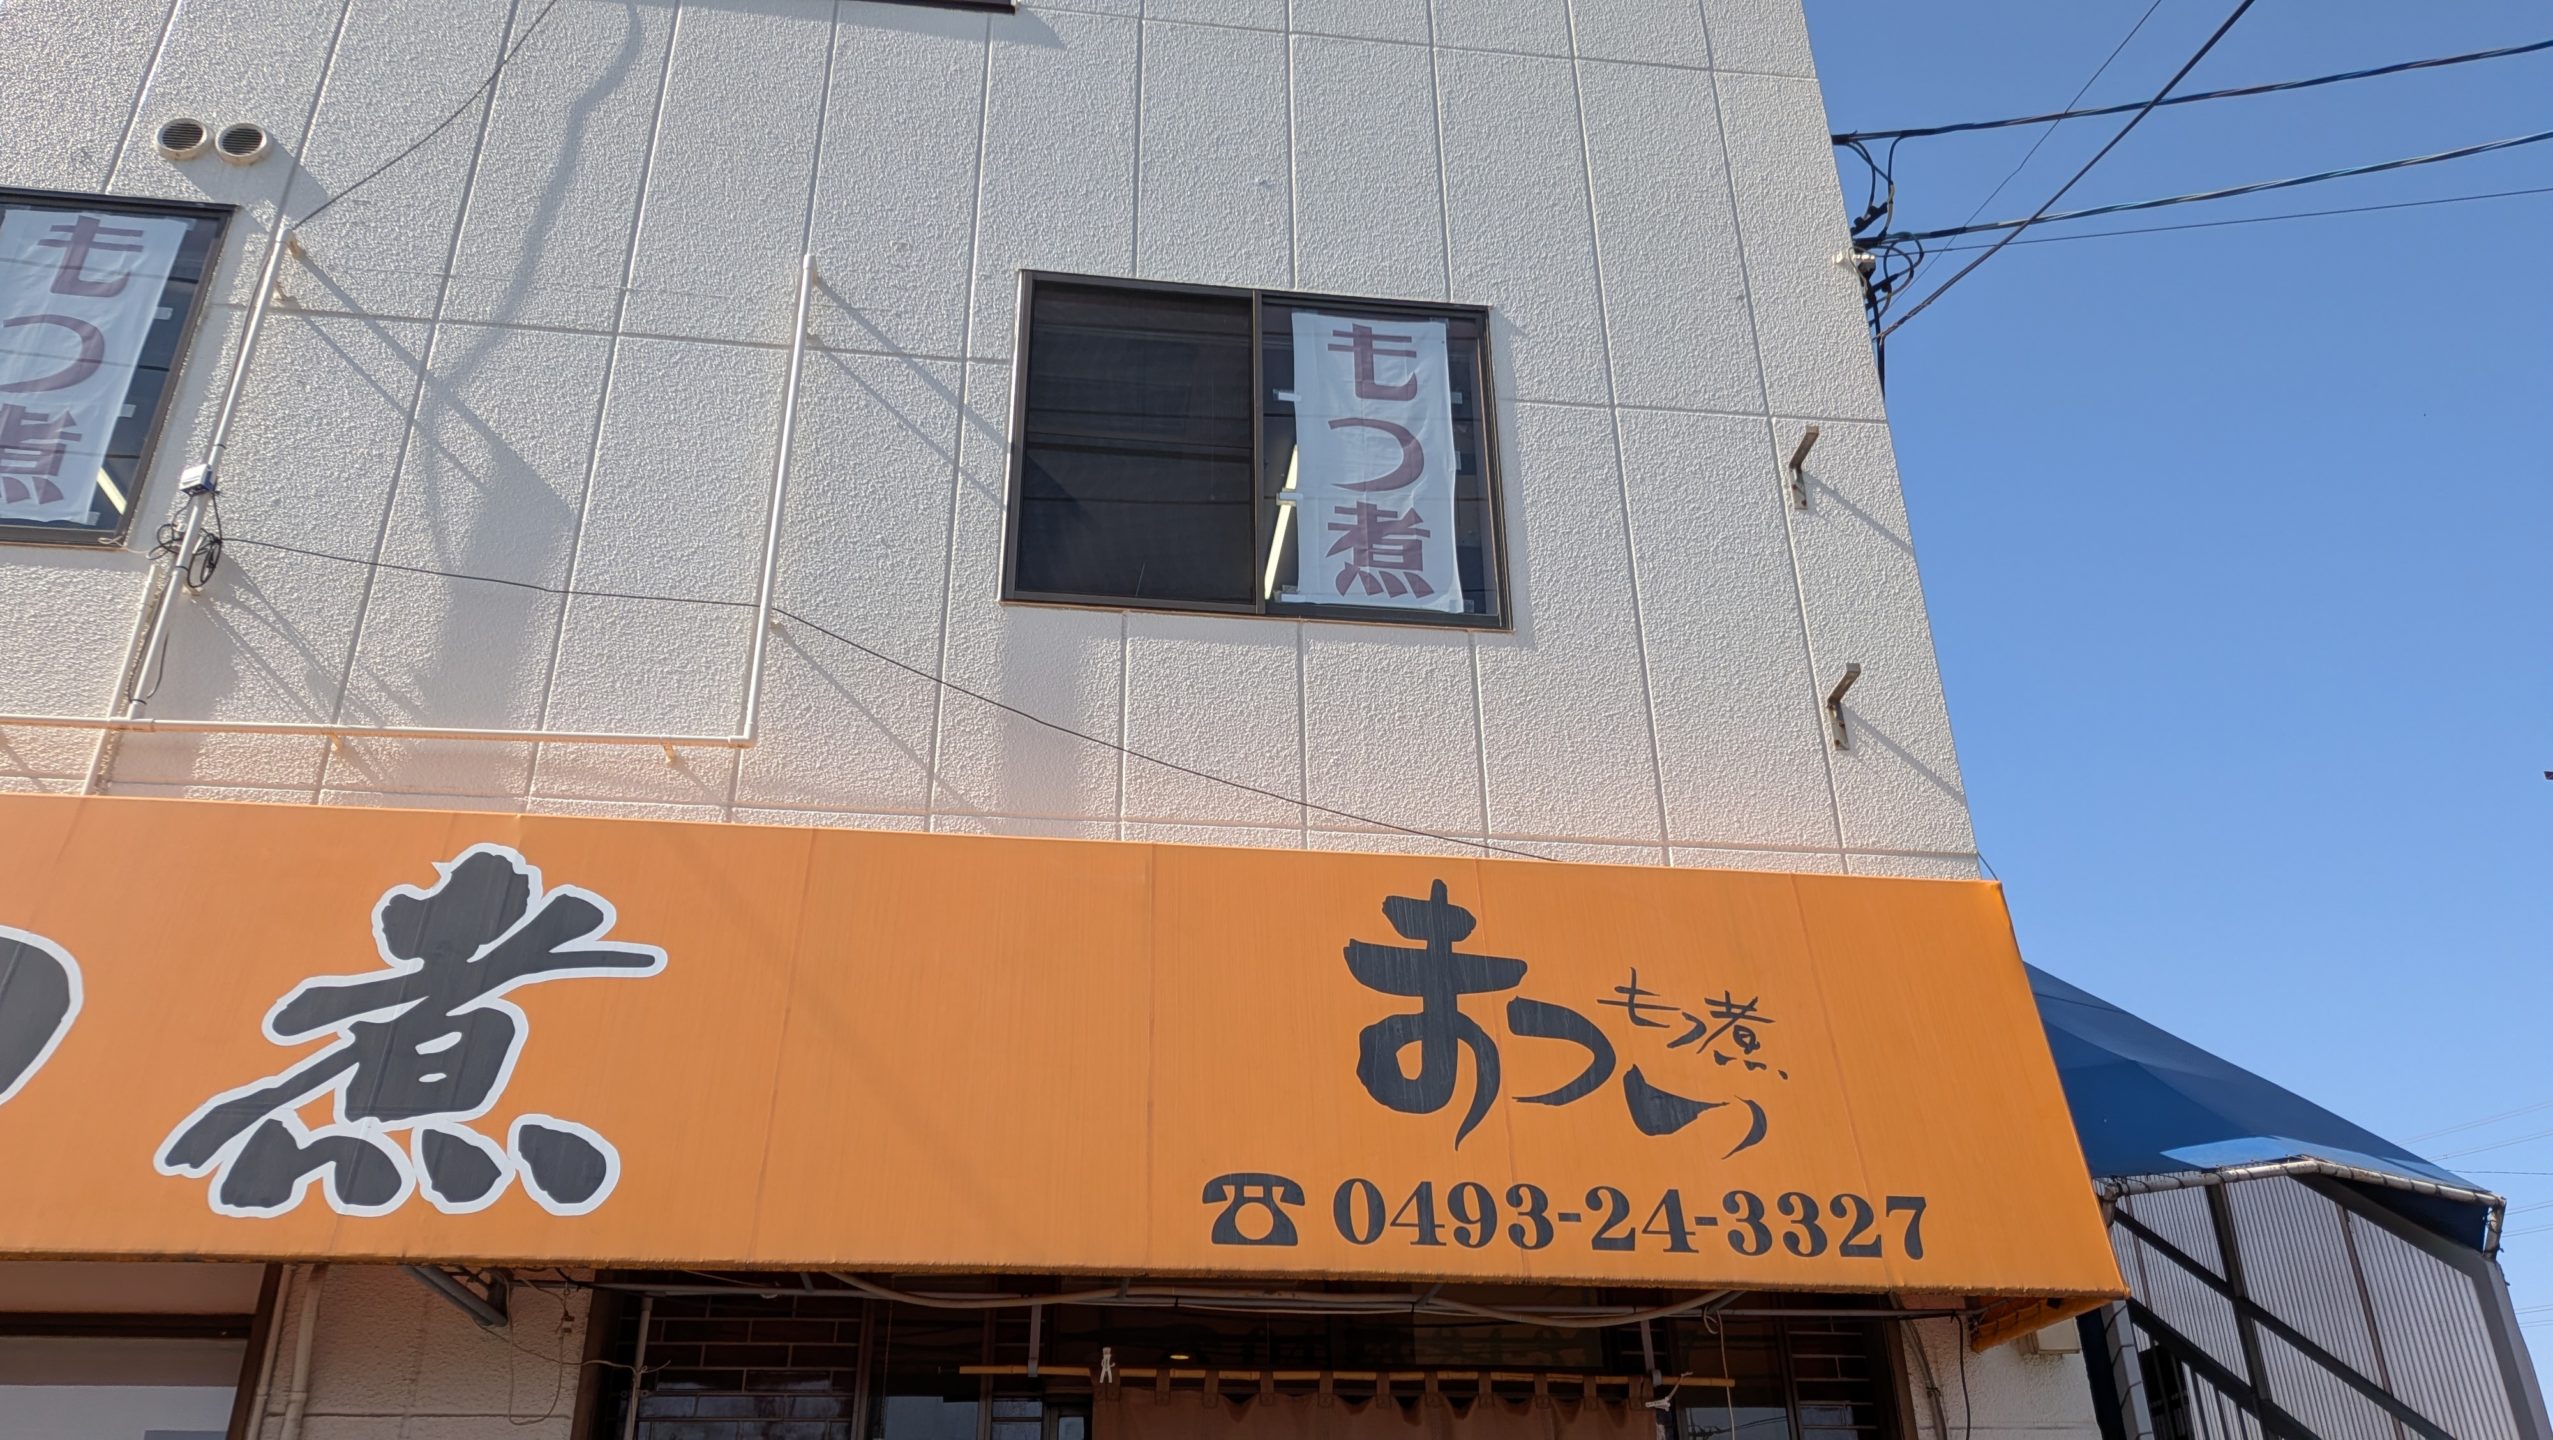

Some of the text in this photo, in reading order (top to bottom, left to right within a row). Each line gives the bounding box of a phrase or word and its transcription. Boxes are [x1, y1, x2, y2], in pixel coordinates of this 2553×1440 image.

[1326, 323, 1435, 599] もつ煮
[1597, 967, 1788, 1080] もつ煮
[1332, 1178, 1927, 1260] 0493-24-3327
